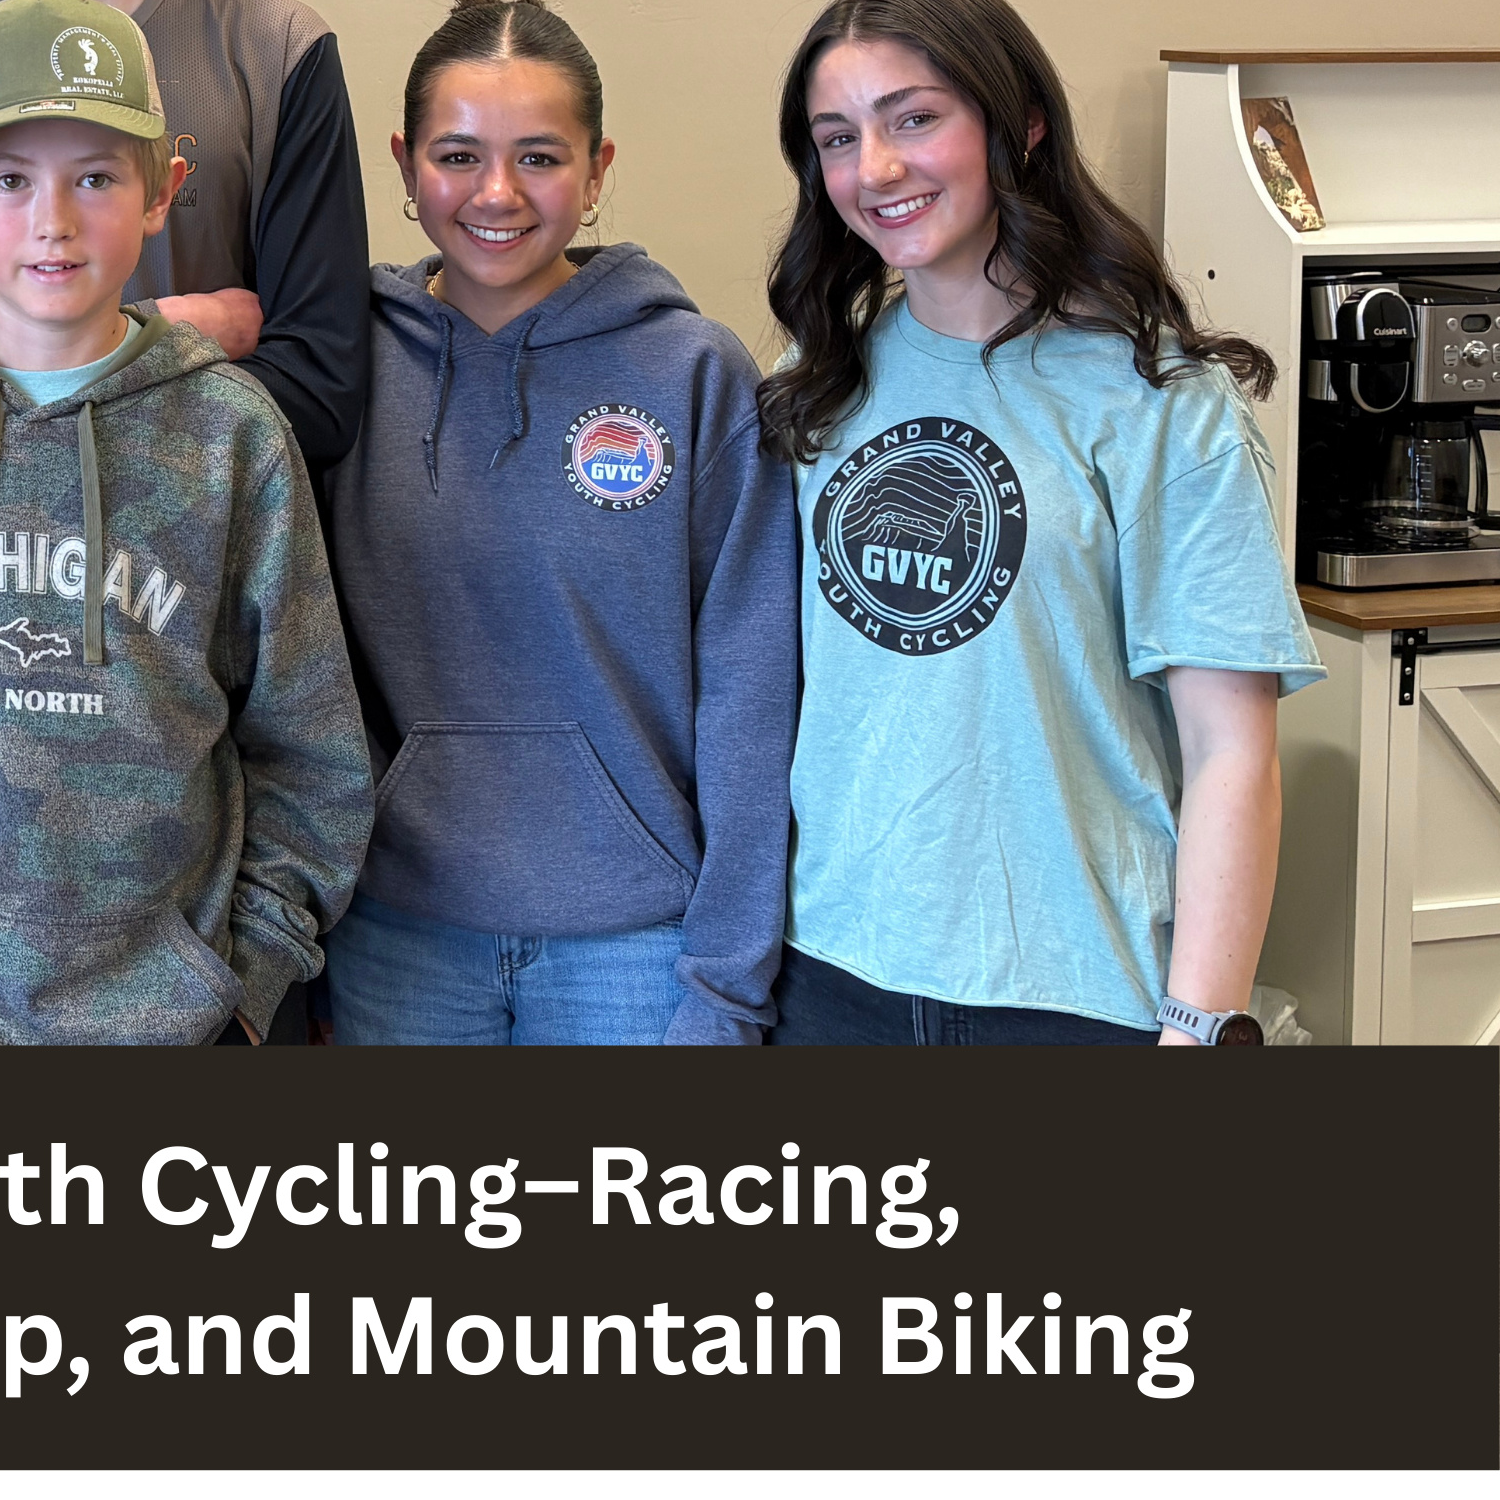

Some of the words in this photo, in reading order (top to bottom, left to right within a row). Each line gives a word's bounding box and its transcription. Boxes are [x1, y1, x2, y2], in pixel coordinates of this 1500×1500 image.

[1373, 327, 1407, 336] Cuisinart
[565, 405, 609, 444] GRAND
[618, 405, 671, 445] VALLEY
[563, 462, 603, 506] YOUTH
[612, 464, 672, 510] CYCLING
[591, 462, 643, 482] GVYC
[825, 423, 922, 497] GRAND
[941, 422, 1022, 520] VALLEY
[861, 544, 953, 595] GVYC
[817, 538, 882, 639] YOUTH
[899, 567, 1012, 651] CYCLING
[4, 688, 104, 716] NORTH
